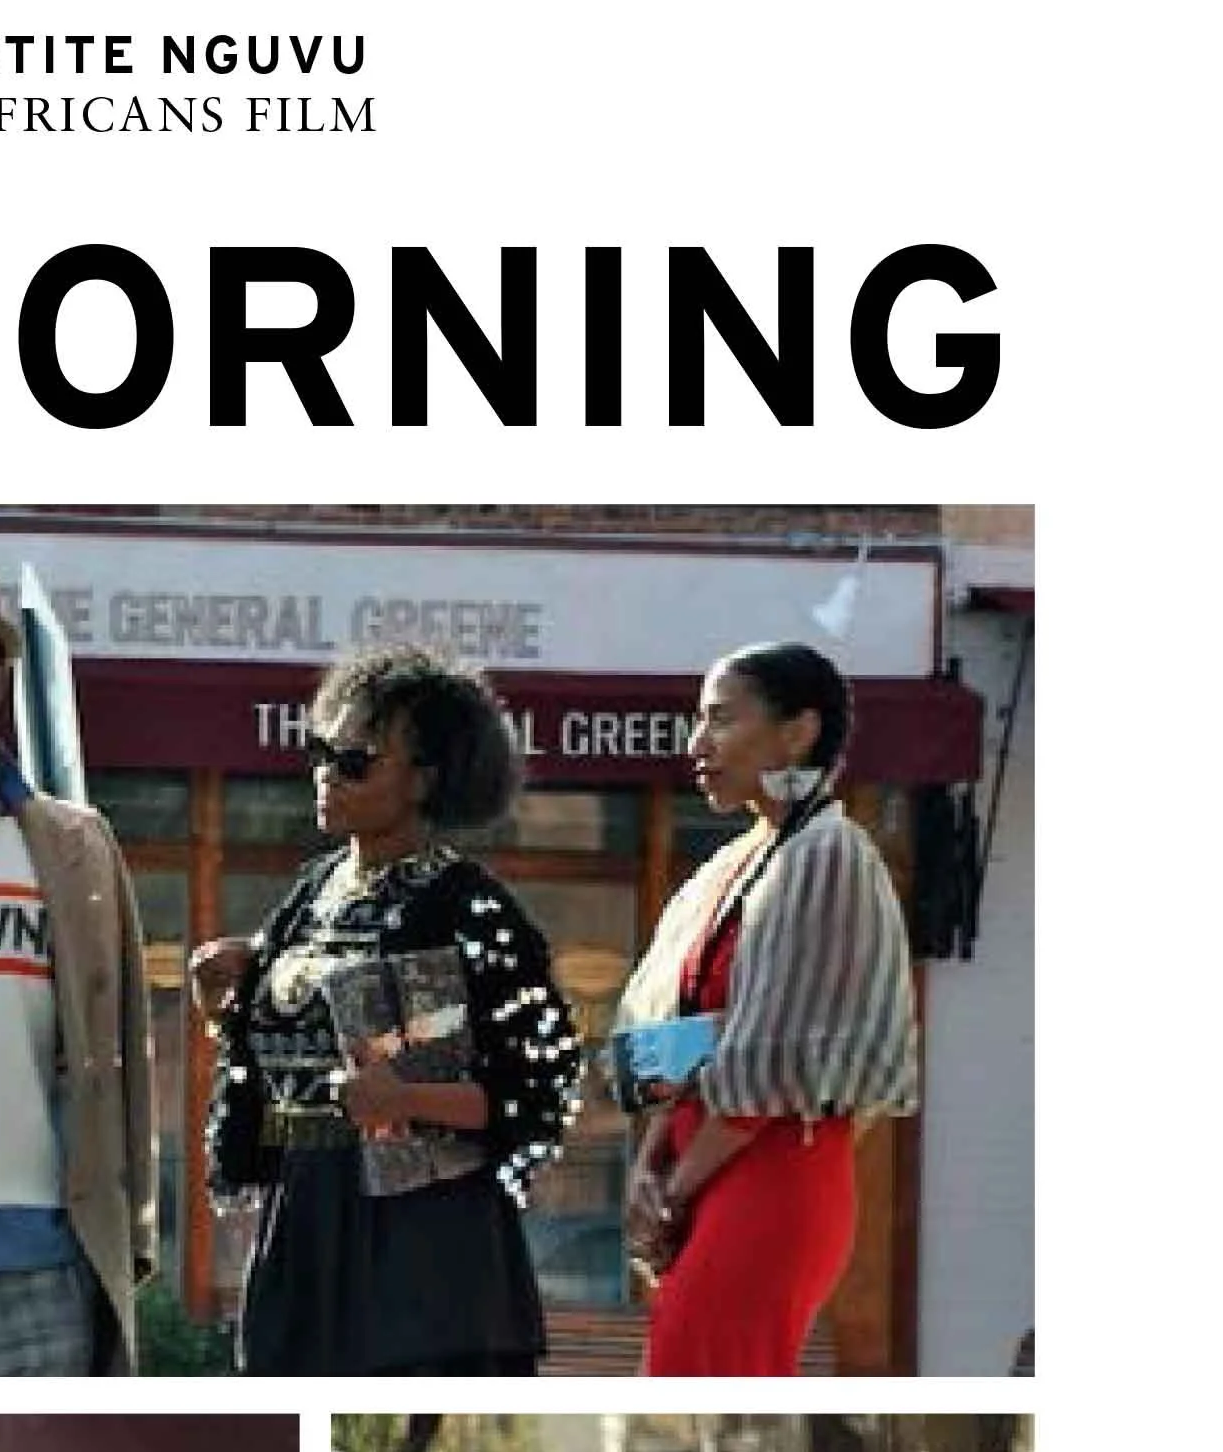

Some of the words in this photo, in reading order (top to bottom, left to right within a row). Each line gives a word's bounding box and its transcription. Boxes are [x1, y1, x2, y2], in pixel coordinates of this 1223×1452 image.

[164, 35, 363, 74] NGUVU
[246, 98, 376, 132] FILM
[109, 590, 335, 650] GENERAL
[254, 704, 315, 747] TH
[561, 712, 703, 757] GREEN
